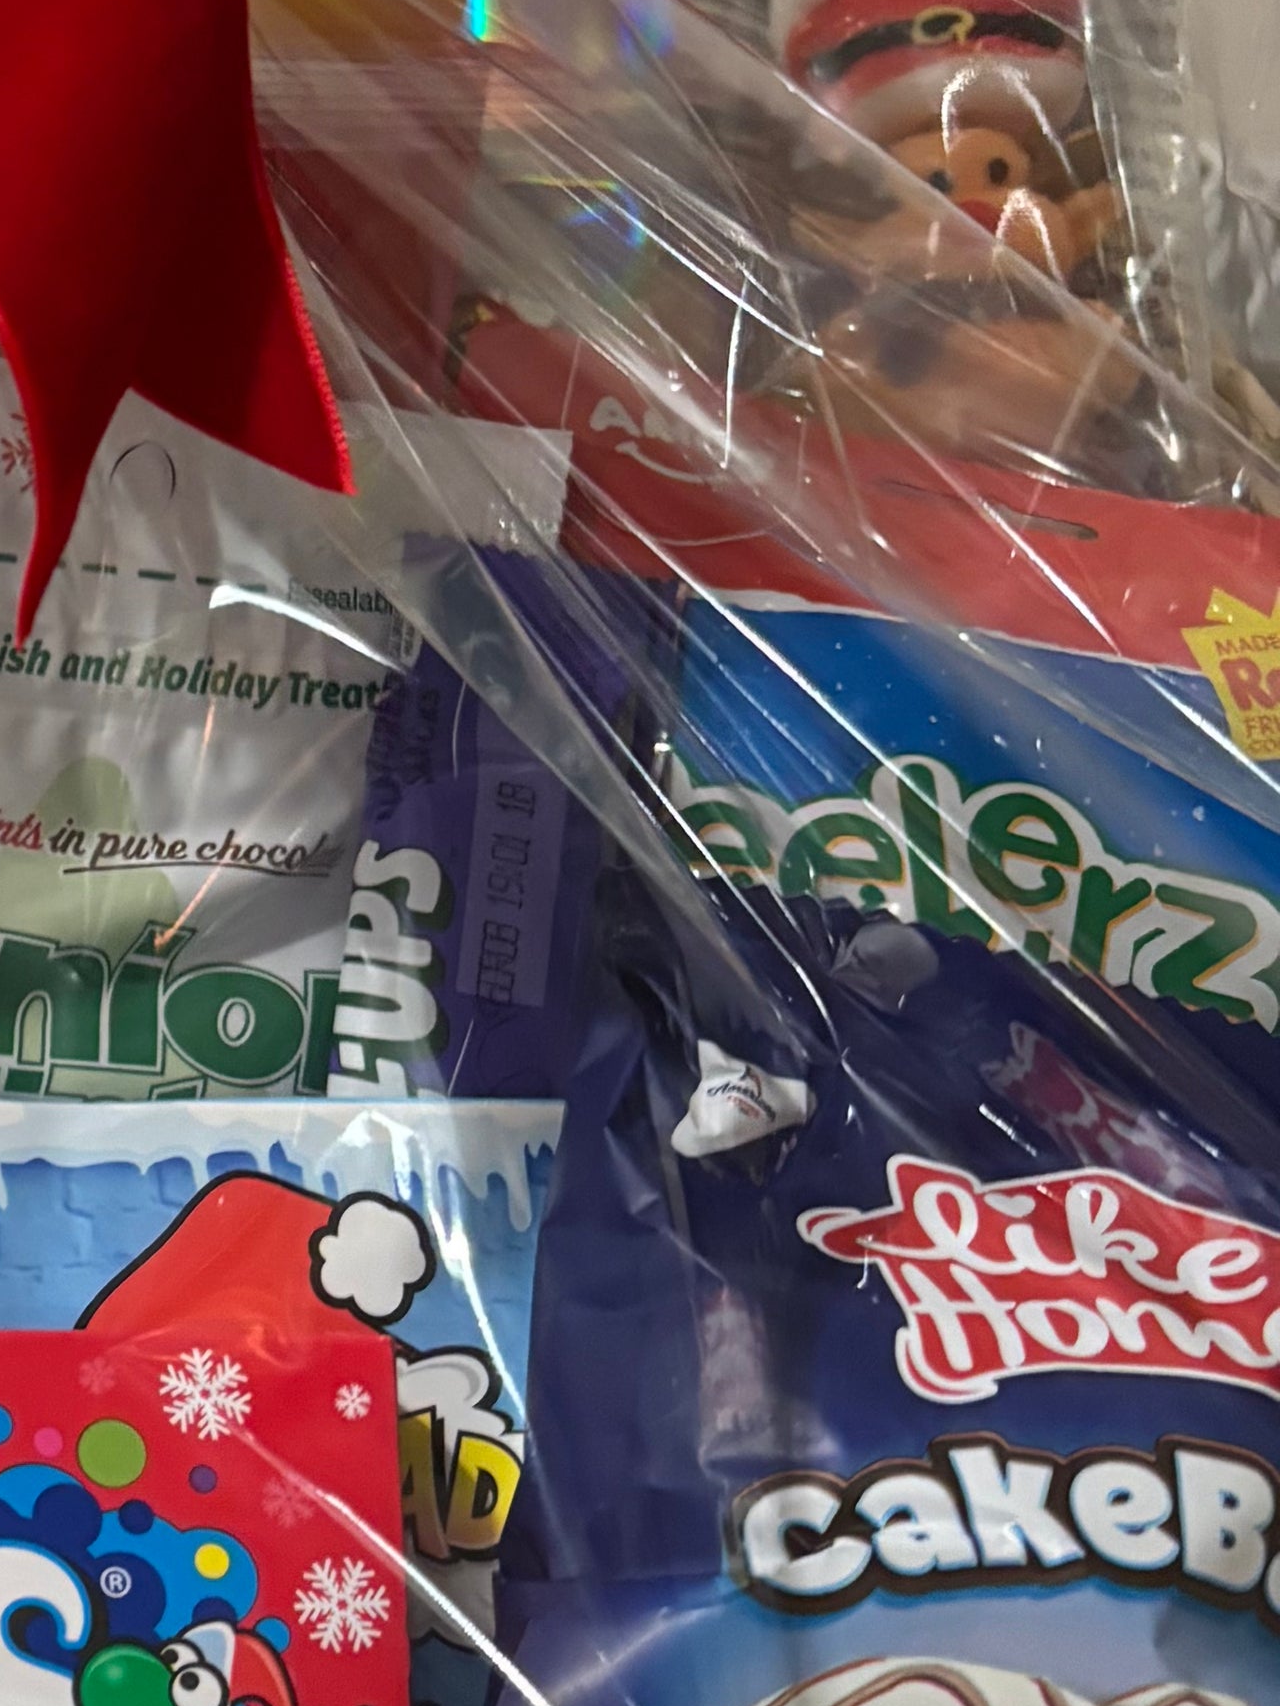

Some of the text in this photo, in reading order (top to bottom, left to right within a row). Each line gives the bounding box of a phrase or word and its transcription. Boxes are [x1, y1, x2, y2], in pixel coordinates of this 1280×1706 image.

[59, 650, 131, 686] and
[137, 654, 282, 710] Holiday
[48, 818, 87, 857] in
[90, 829, 188, 870] pure
